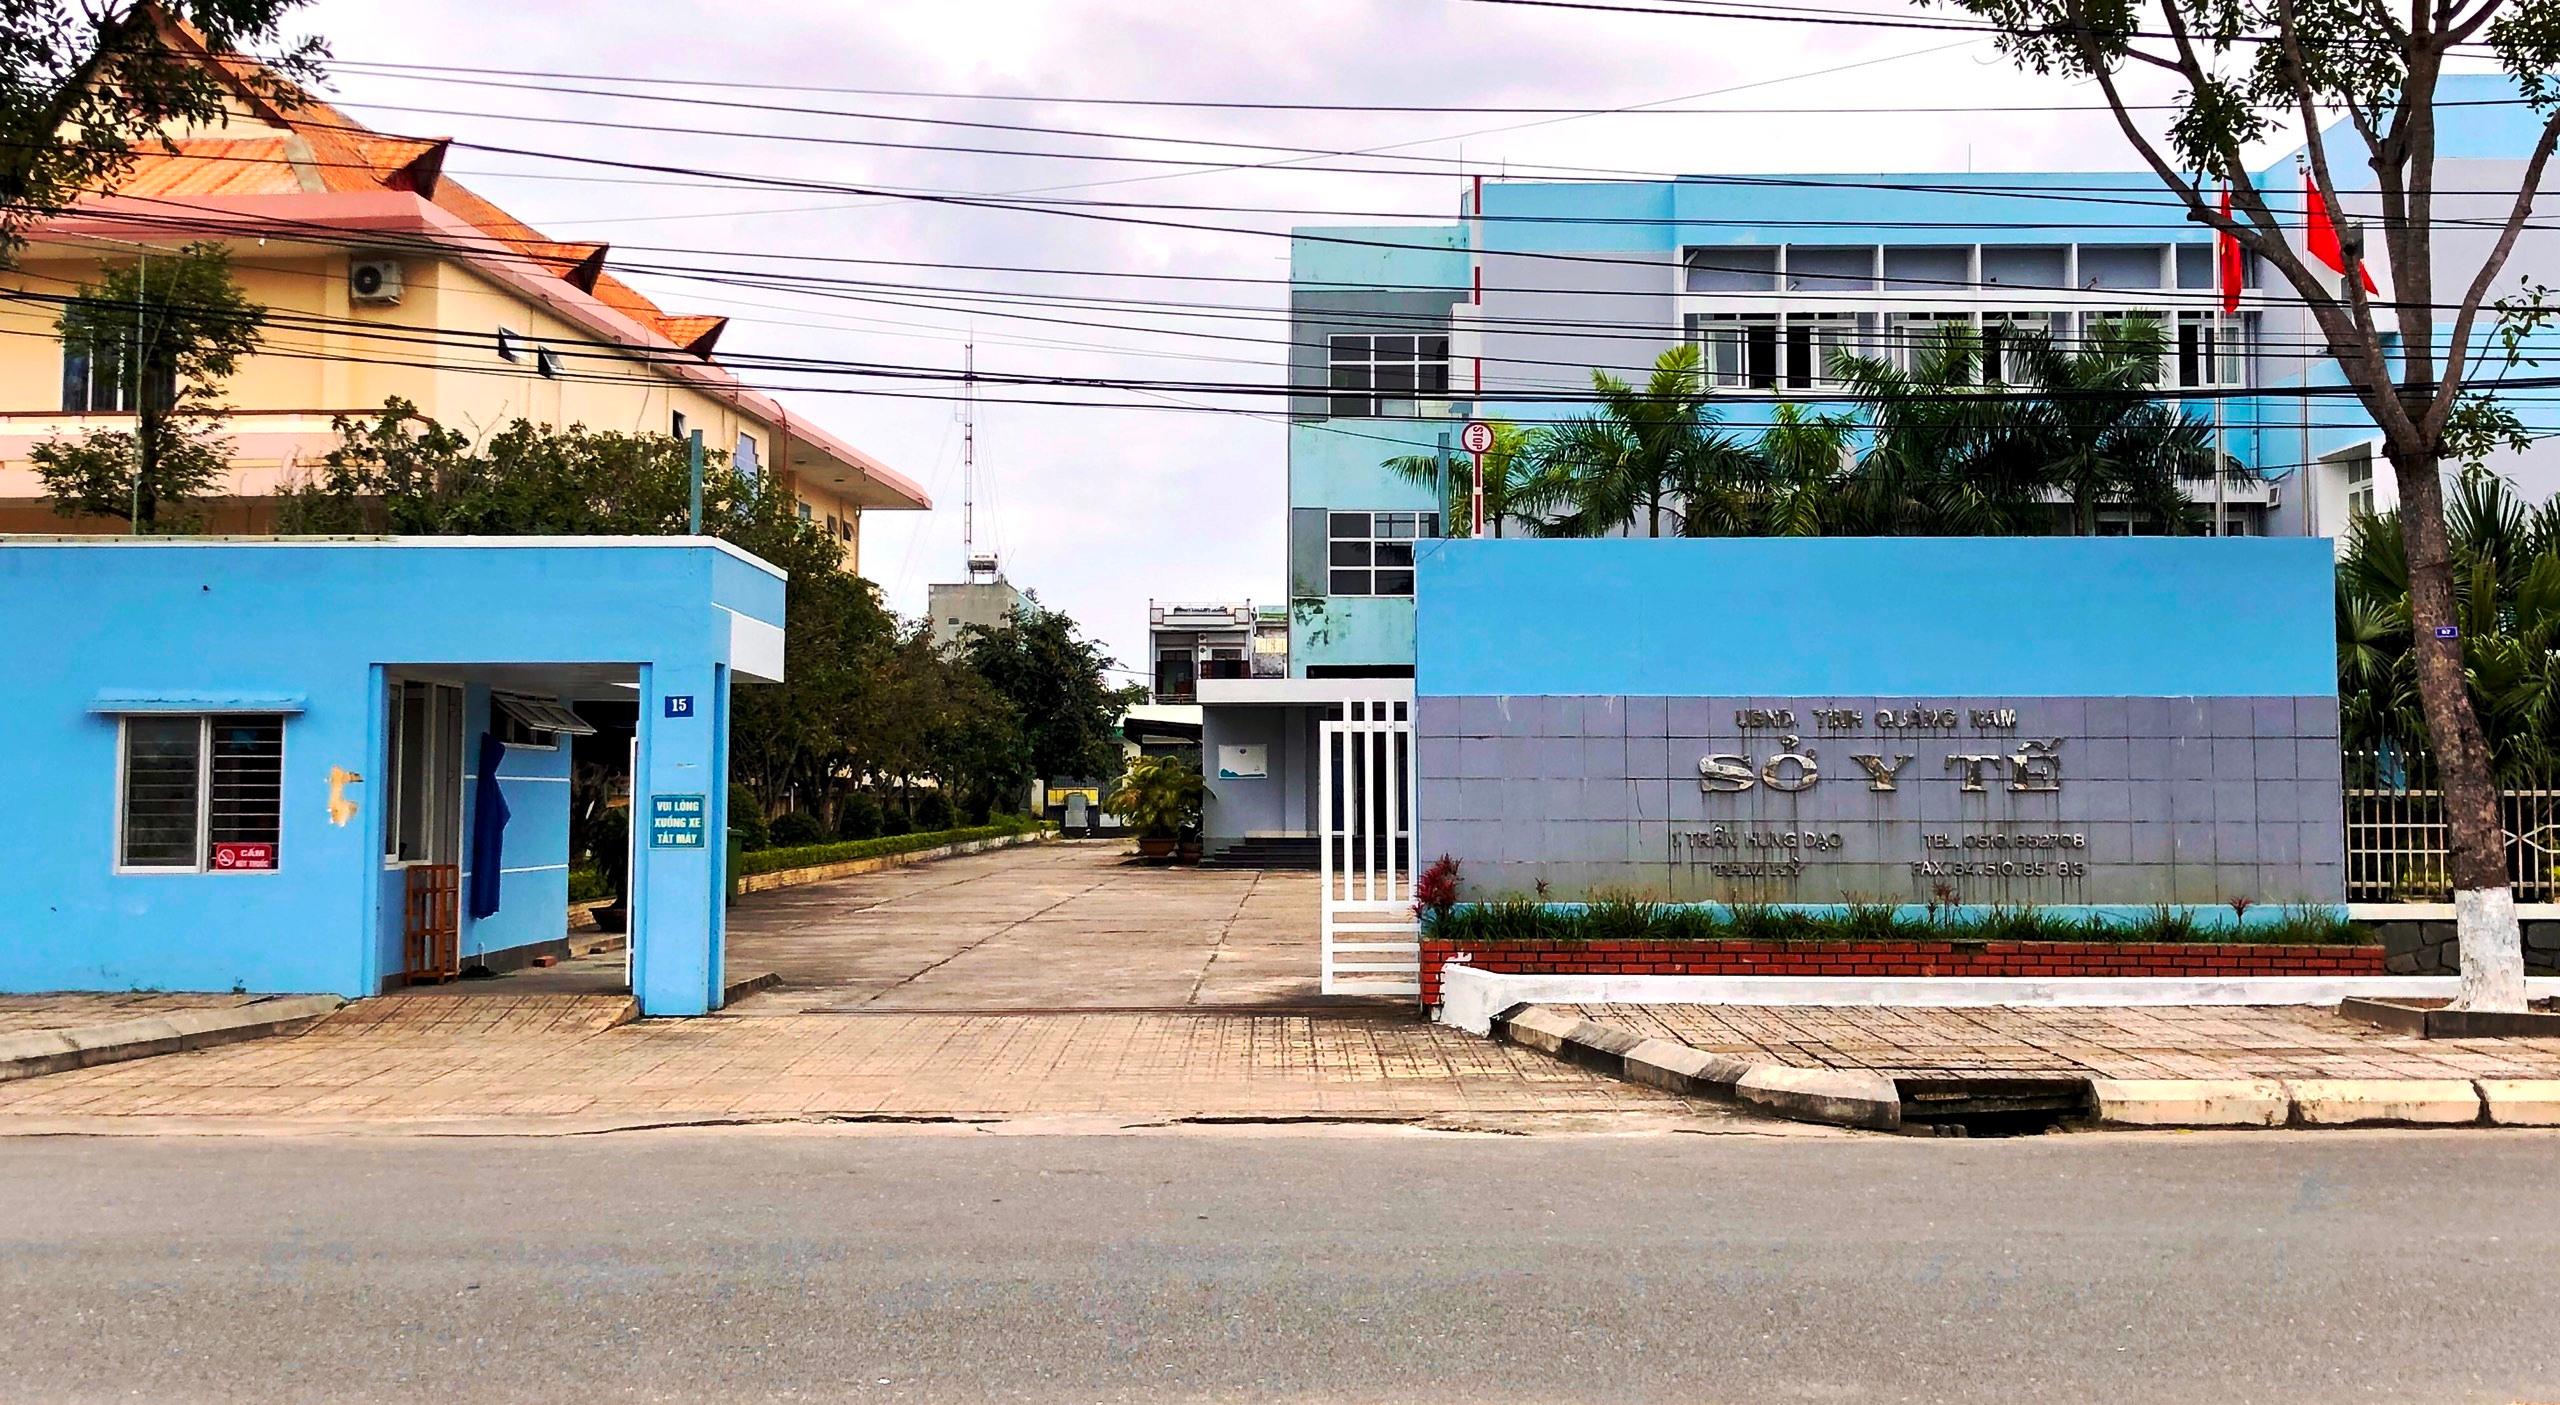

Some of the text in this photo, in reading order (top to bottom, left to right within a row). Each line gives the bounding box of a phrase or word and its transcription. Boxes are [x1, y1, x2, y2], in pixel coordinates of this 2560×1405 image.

[1472, 426, 1484, 450] STOP
[672, 698, 687, 712] 15
[1968, 708, 2016, 729] NAM
[1849, 753, 1915, 792] Y
[1943, 737, 2066, 793] TẾ
[656, 801, 672, 811] VUI
[688, 817, 701, 828] XE
